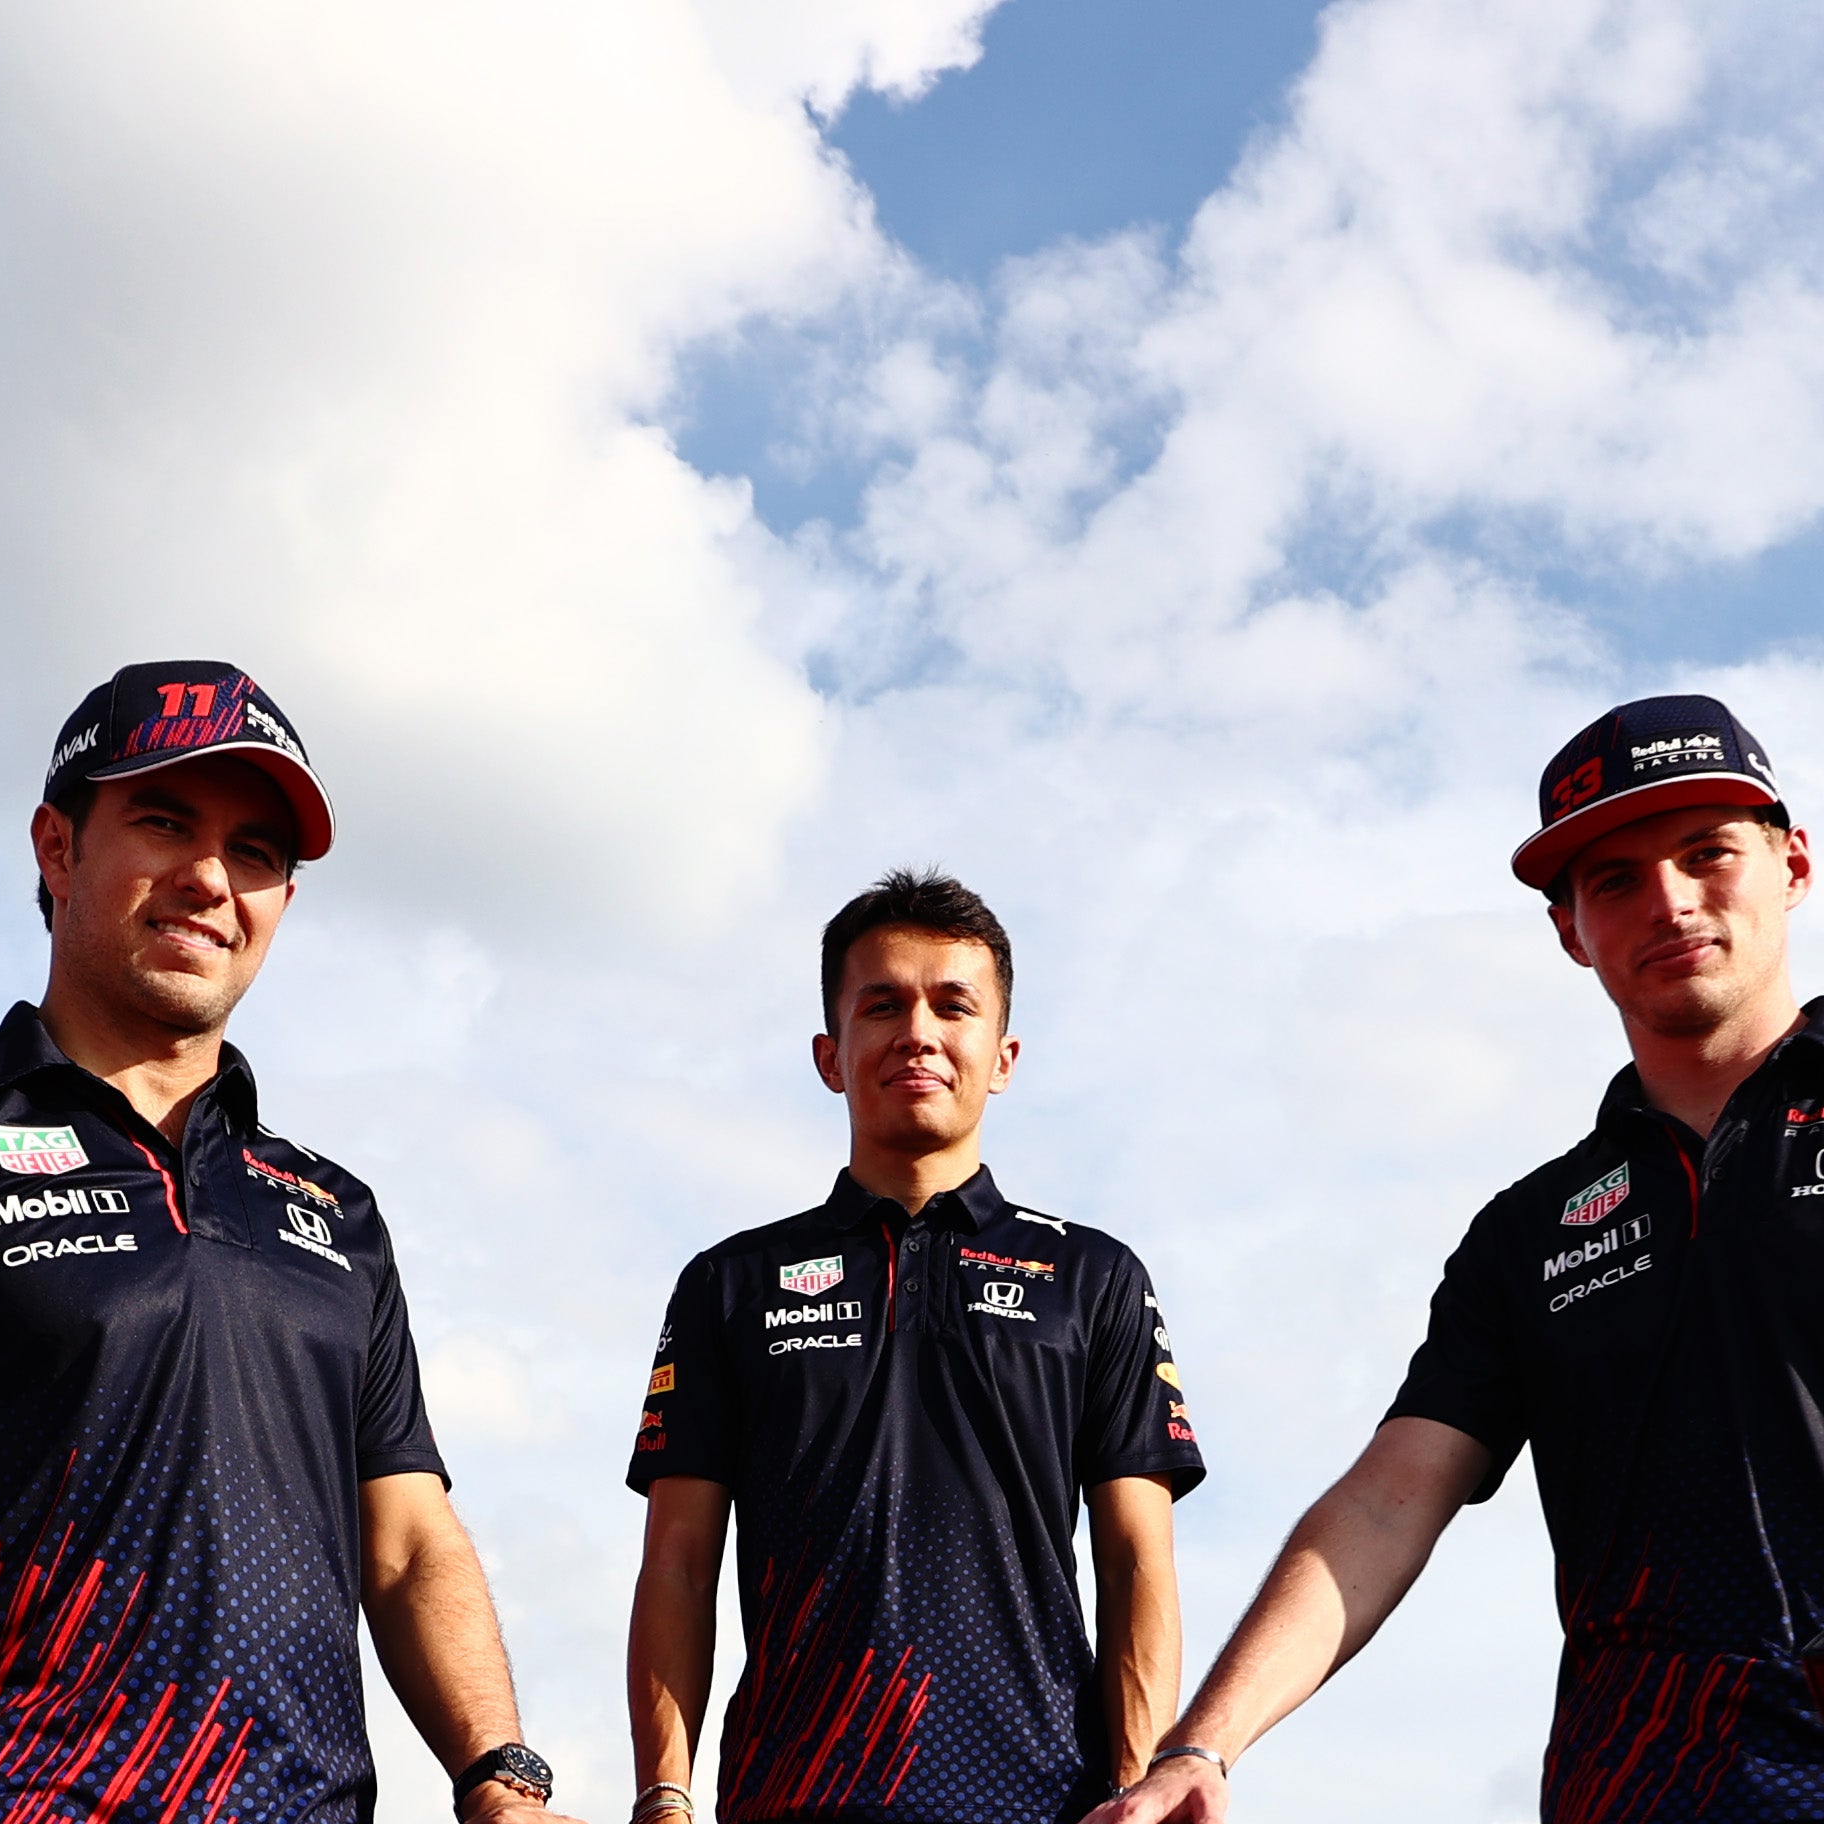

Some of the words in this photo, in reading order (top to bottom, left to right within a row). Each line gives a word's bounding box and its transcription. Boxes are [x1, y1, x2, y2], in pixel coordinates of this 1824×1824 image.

[156, 682, 218, 718] 11
[1631, 742, 1656, 759] Red
[1656, 737, 1682, 752] Bull
[1633, 752, 1725, 772] RACING
[1550, 756, 1604, 819] 33
[3, 1151, 83, 1173] HEUER
[242, 1148, 268, 1171] Red
[247, 1167, 344, 1219] RACING
[1570, 1170, 1625, 1208] TAG
[1566, 1184, 1626, 1223] HEUER
[2, 1234, 139, 1267] ORACLE
[277, 1228, 352, 1271] HONDA
[959, 1247, 987, 1260] Red
[986, 1253, 1013, 1266] Bull
[1543, 1228, 1619, 1281] Mobil
[785, 1259, 839, 1277] TAG
[959, 1260, 1055, 1282] RACING
[785, 1272, 841, 1292] HEUER
[1549, 1253, 1653, 1312] ORACLE
[765, 1303, 833, 1329] Mobil
[967, 1302, 1037, 1322] HONDA
[768, 1333, 863, 1355] ORACLE
[1167, 1421, 1196, 1441] Re
